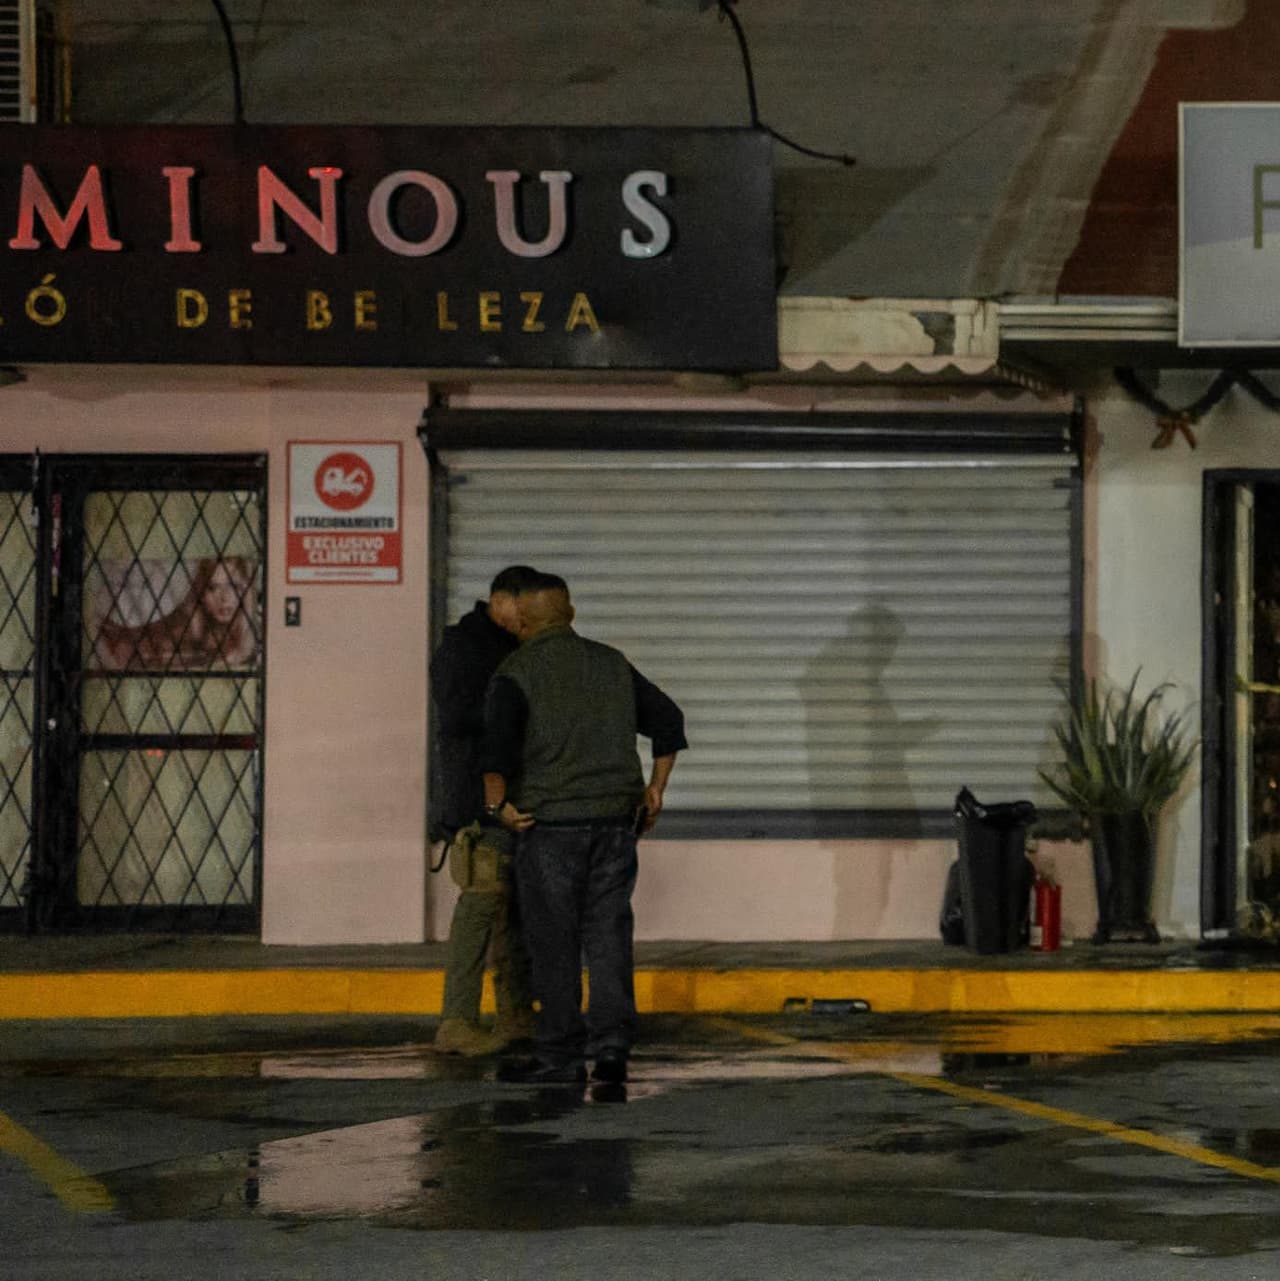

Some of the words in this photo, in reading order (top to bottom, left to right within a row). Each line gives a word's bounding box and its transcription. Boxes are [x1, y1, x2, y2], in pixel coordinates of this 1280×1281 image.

[8, 164, 672, 259] MINOUS
[176, 288, 253, 329] DE
[302, 536, 385, 550] EXCLUSIVO
[308, 551, 379, 564] CLIENTES
